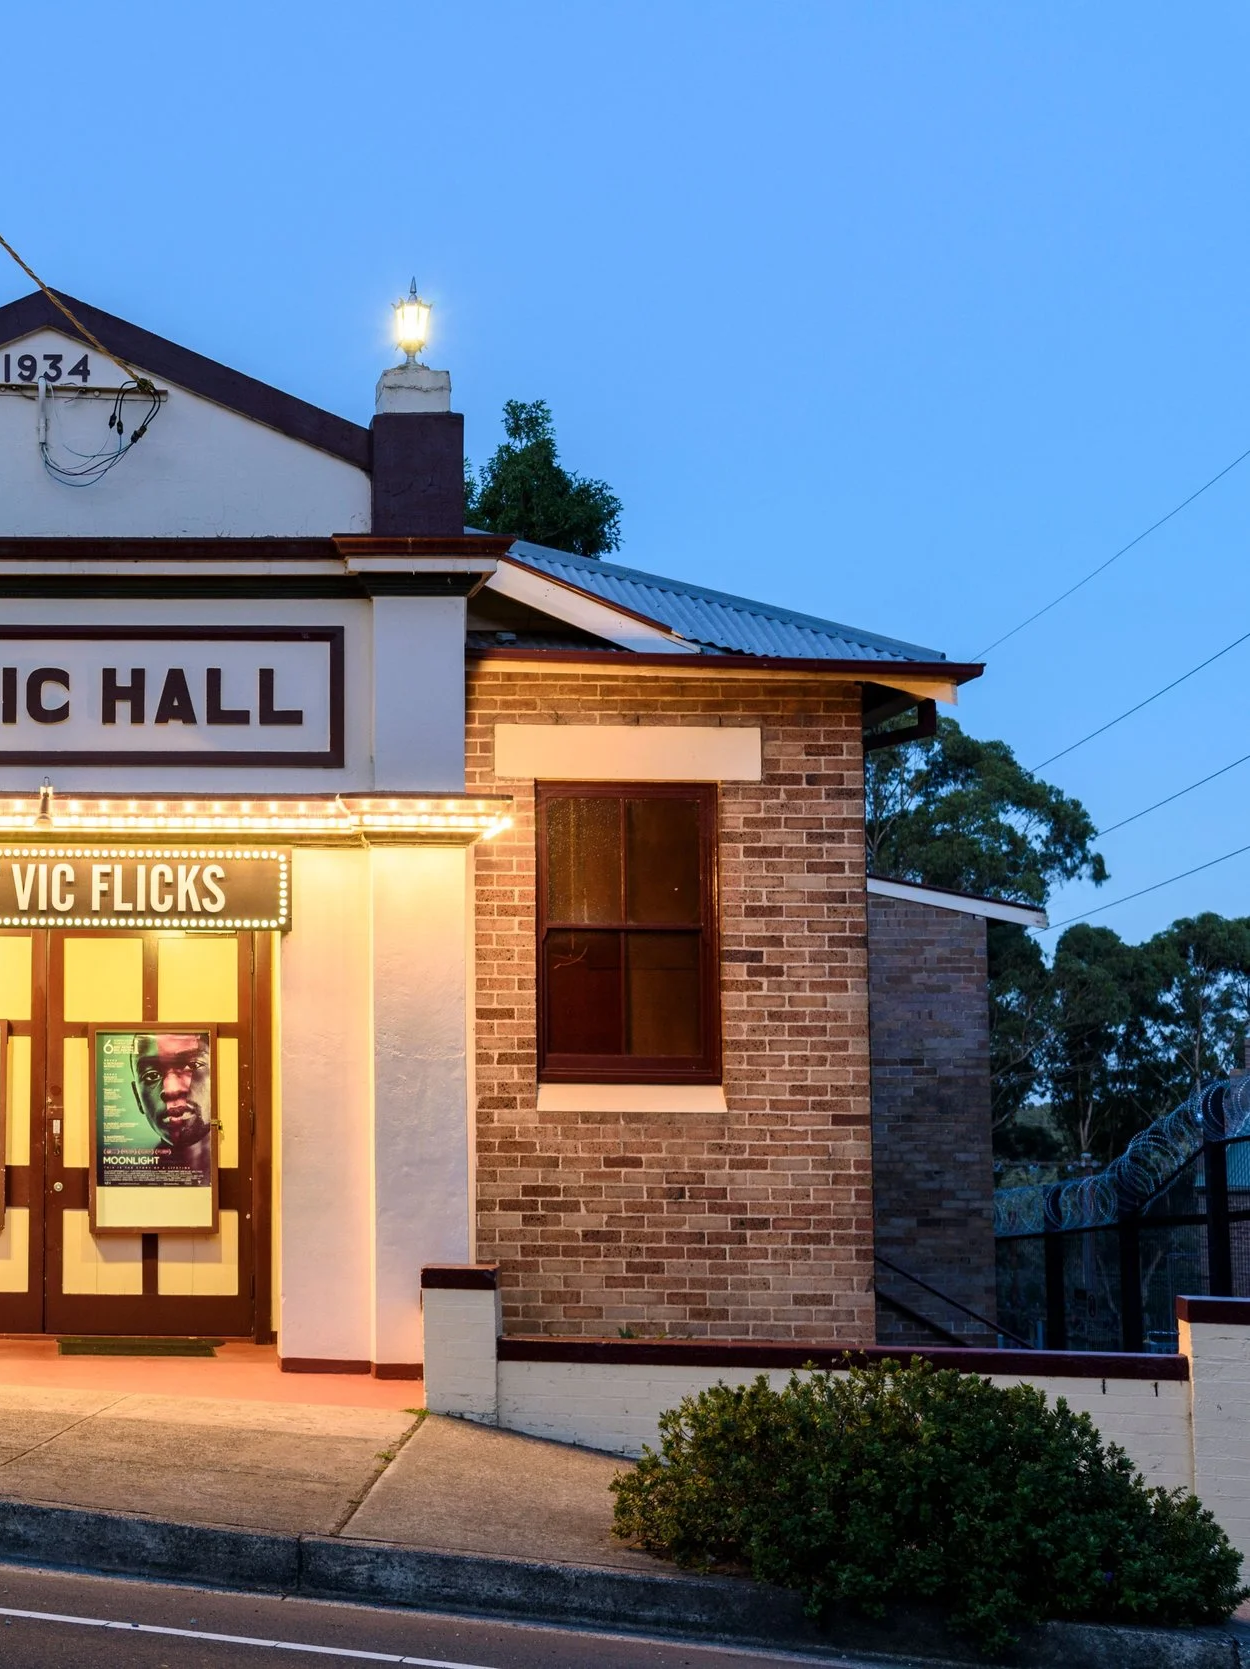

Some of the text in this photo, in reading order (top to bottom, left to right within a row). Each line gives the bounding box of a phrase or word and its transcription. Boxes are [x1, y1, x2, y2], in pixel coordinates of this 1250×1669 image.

[4, 353, 91, 383] 1934
[101, 668, 304, 725] HALL
[11, 863, 75, 912] VIC
[91, 864, 226, 912] FLICKS
[103, 1039, 114, 1054] 6
[103, 1156, 160, 1165] MOONLIGHT
